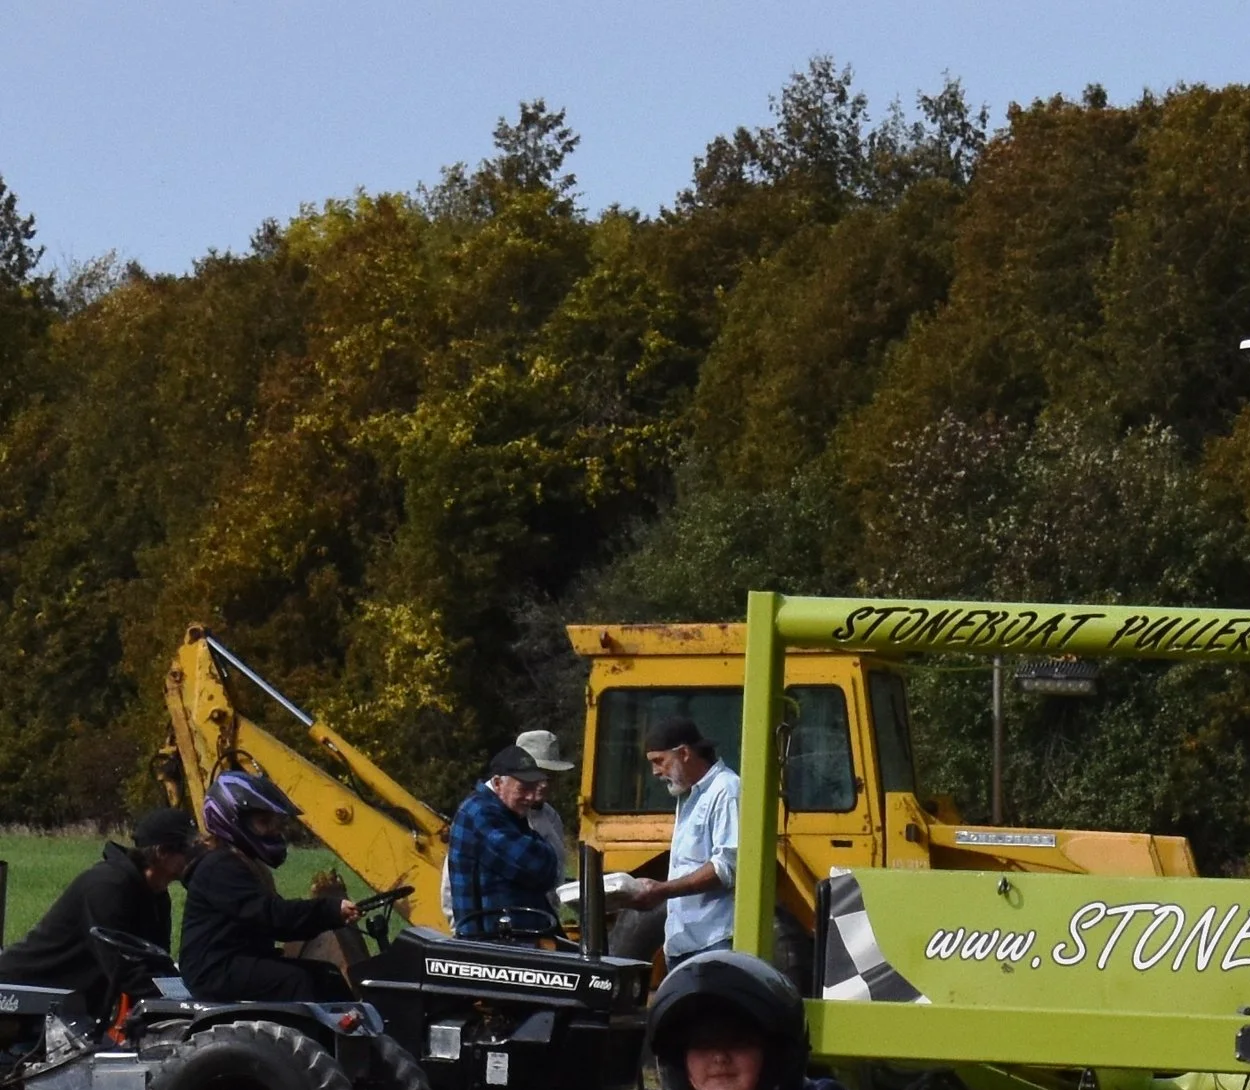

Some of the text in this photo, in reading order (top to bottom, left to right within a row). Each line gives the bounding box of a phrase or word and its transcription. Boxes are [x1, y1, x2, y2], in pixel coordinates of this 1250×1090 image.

[832, 606, 1106, 651] STONEBOAT
[430, 960, 612, 992] INTERNATIONAL Turbo
